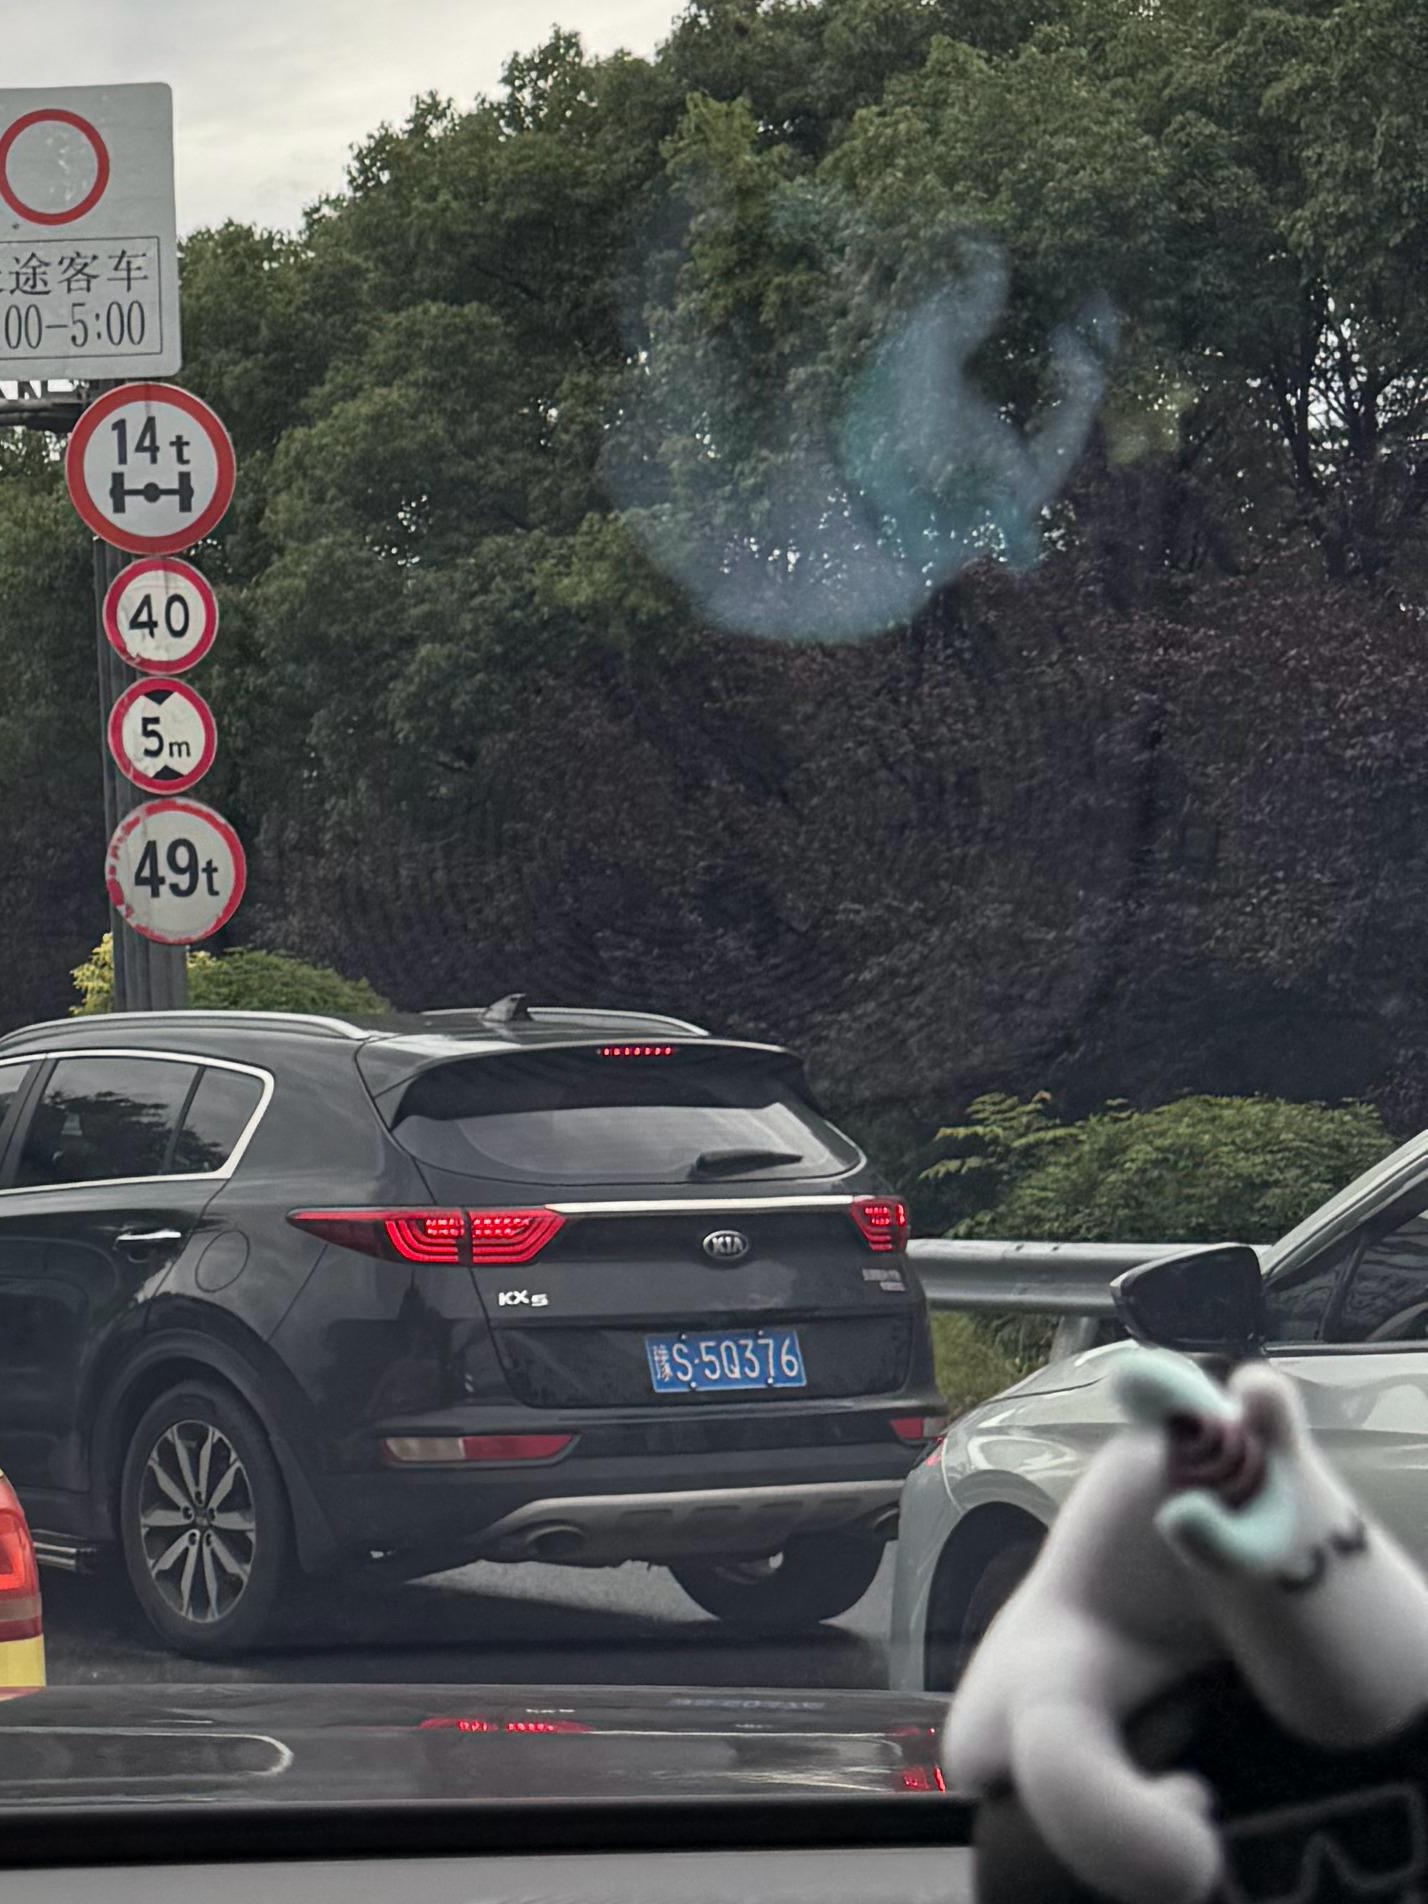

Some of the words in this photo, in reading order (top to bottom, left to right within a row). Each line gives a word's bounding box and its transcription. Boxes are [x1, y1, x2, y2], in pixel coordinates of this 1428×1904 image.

[128, 594, 190, 638] 40
[141, 717, 191, 758] 5m
[134, 840, 220, 898] 49t
[711, 1235, 744, 1254] KIA
